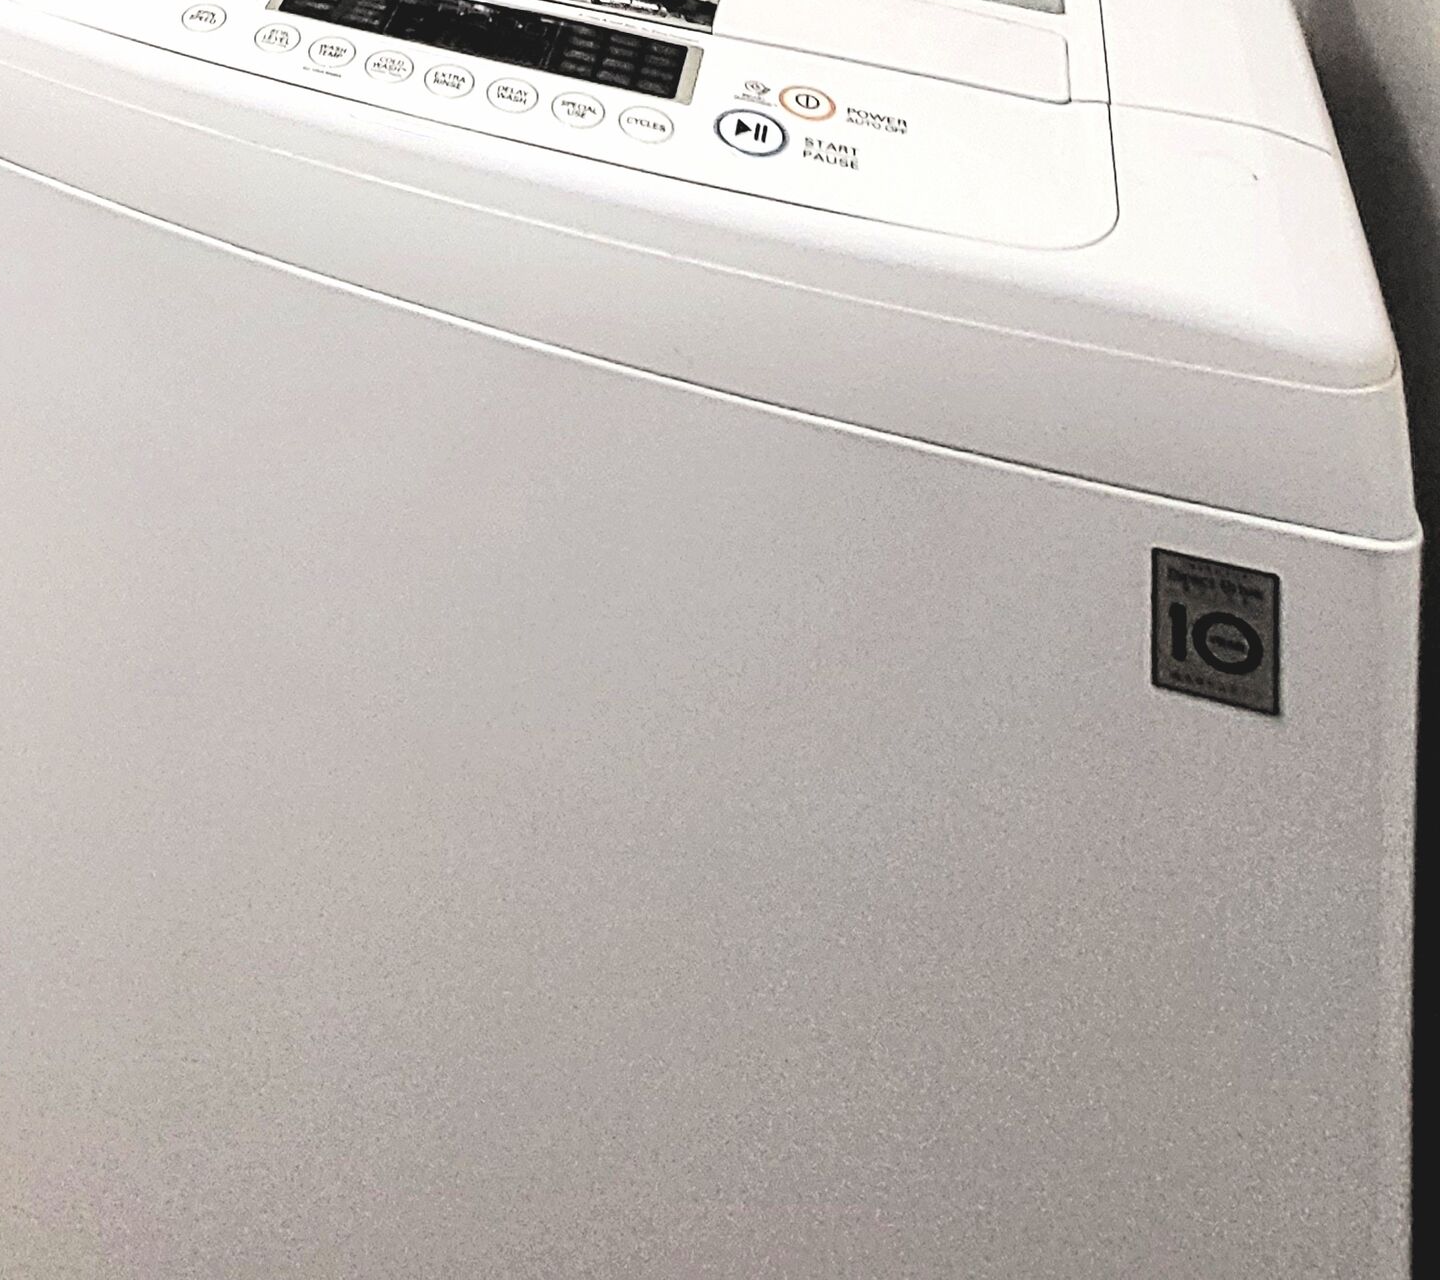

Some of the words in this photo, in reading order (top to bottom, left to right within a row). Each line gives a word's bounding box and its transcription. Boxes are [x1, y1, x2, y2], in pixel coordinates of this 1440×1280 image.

[433, 77, 462, 90] RINSE
[434, 71, 466, 85] EXTRA
[497, 84, 529, 98] DELAY
[497, 92, 527, 106] WASH
[561, 99, 598, 116] SPECIAL
[566, 108, 587, 120] USE
[626, 116, 667, 133] CYCLES
[847, 106, 908, 128] POWER
[846, 116, 882, 131] AUTO
[884, 124, 908, 136] OFF
[804, 136, 860, 157] START
[803, 149, 860, 171] PAUSE
